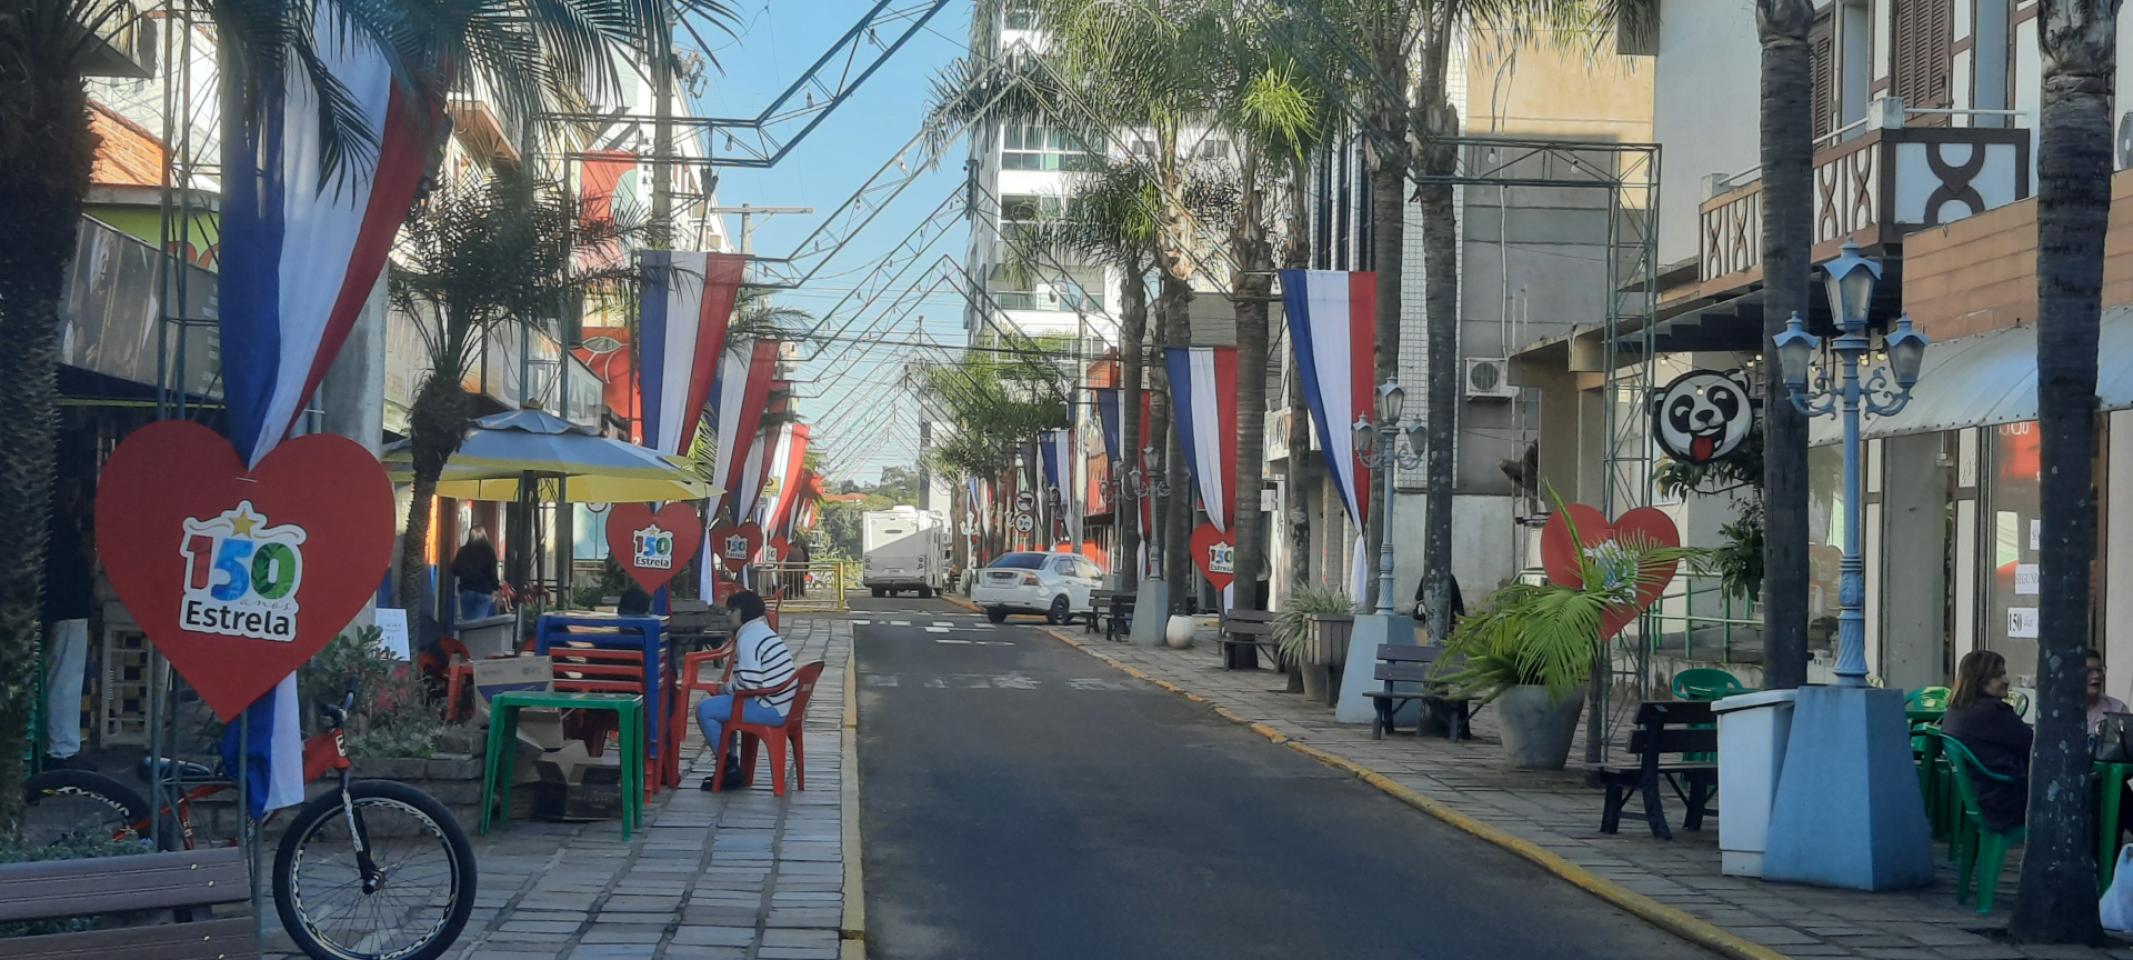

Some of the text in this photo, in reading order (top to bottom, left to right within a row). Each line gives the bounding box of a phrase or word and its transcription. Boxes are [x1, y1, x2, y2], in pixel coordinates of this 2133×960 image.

[635, 535, 670, 556] 150
[726, 540, 746, 552] 150
[1210, 549, 1233, 563] 150
[186, 535, 296, 601] 150
[636, 556, 670, 567] Estrela
[186, 600, 290, 636] Estrela
[2009, 612, 2023, 633] 150
